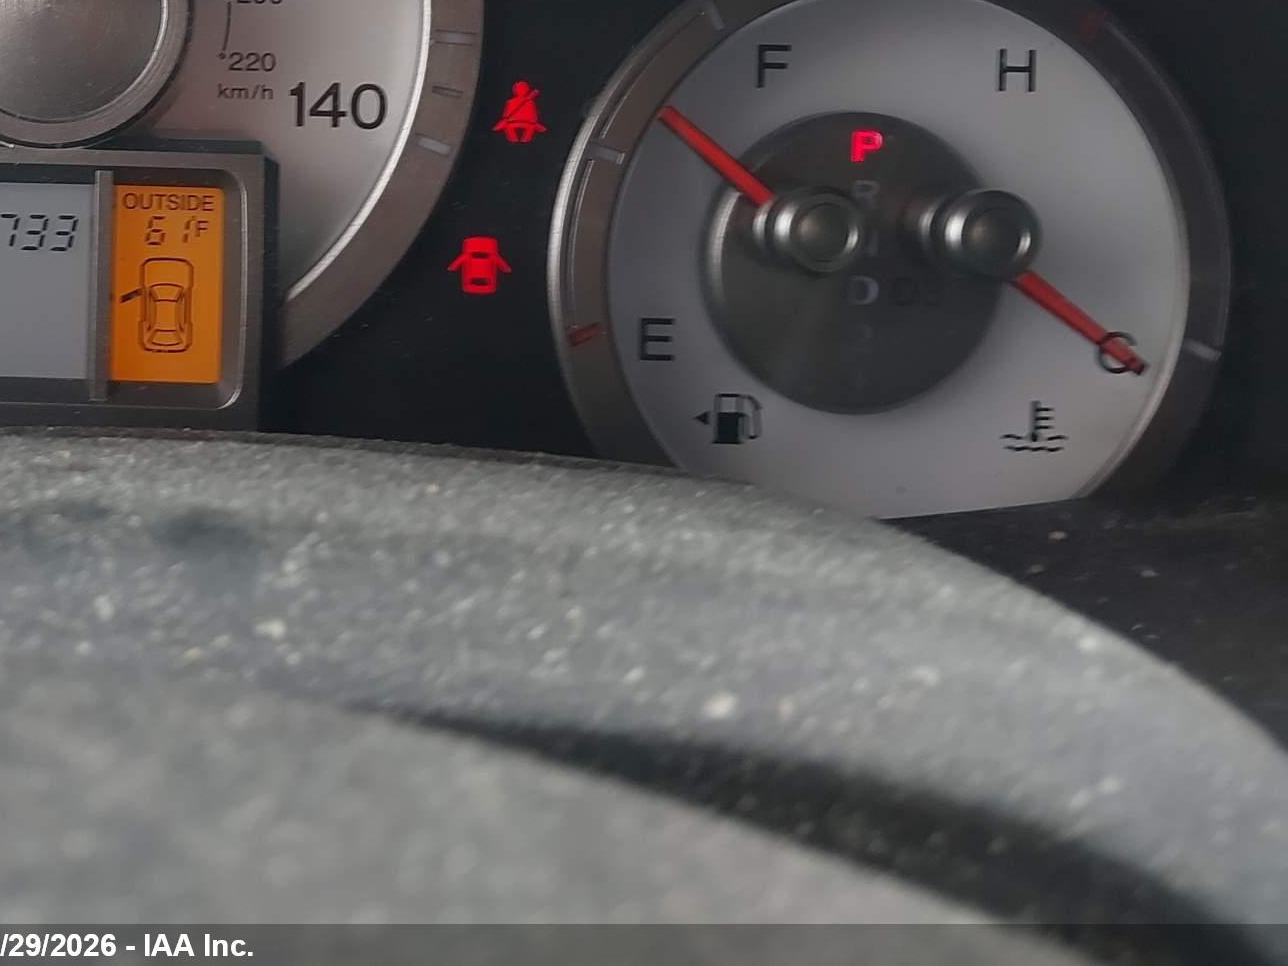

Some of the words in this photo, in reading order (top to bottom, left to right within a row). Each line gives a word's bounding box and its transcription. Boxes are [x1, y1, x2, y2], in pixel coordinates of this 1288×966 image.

[228, 52, 276, 72] 220
[757, 44, 792, 88] F
[998, 48, 1037, 93] H
[217, 85, 274, 100] km/h
[289, 82, 388, 130] 140
[851, 131, 883, 161] P
[122, 193, 215, 211] OUTSIDE
[640, 318, 674, 362] E
[1097, 331, 1139, 374] C
